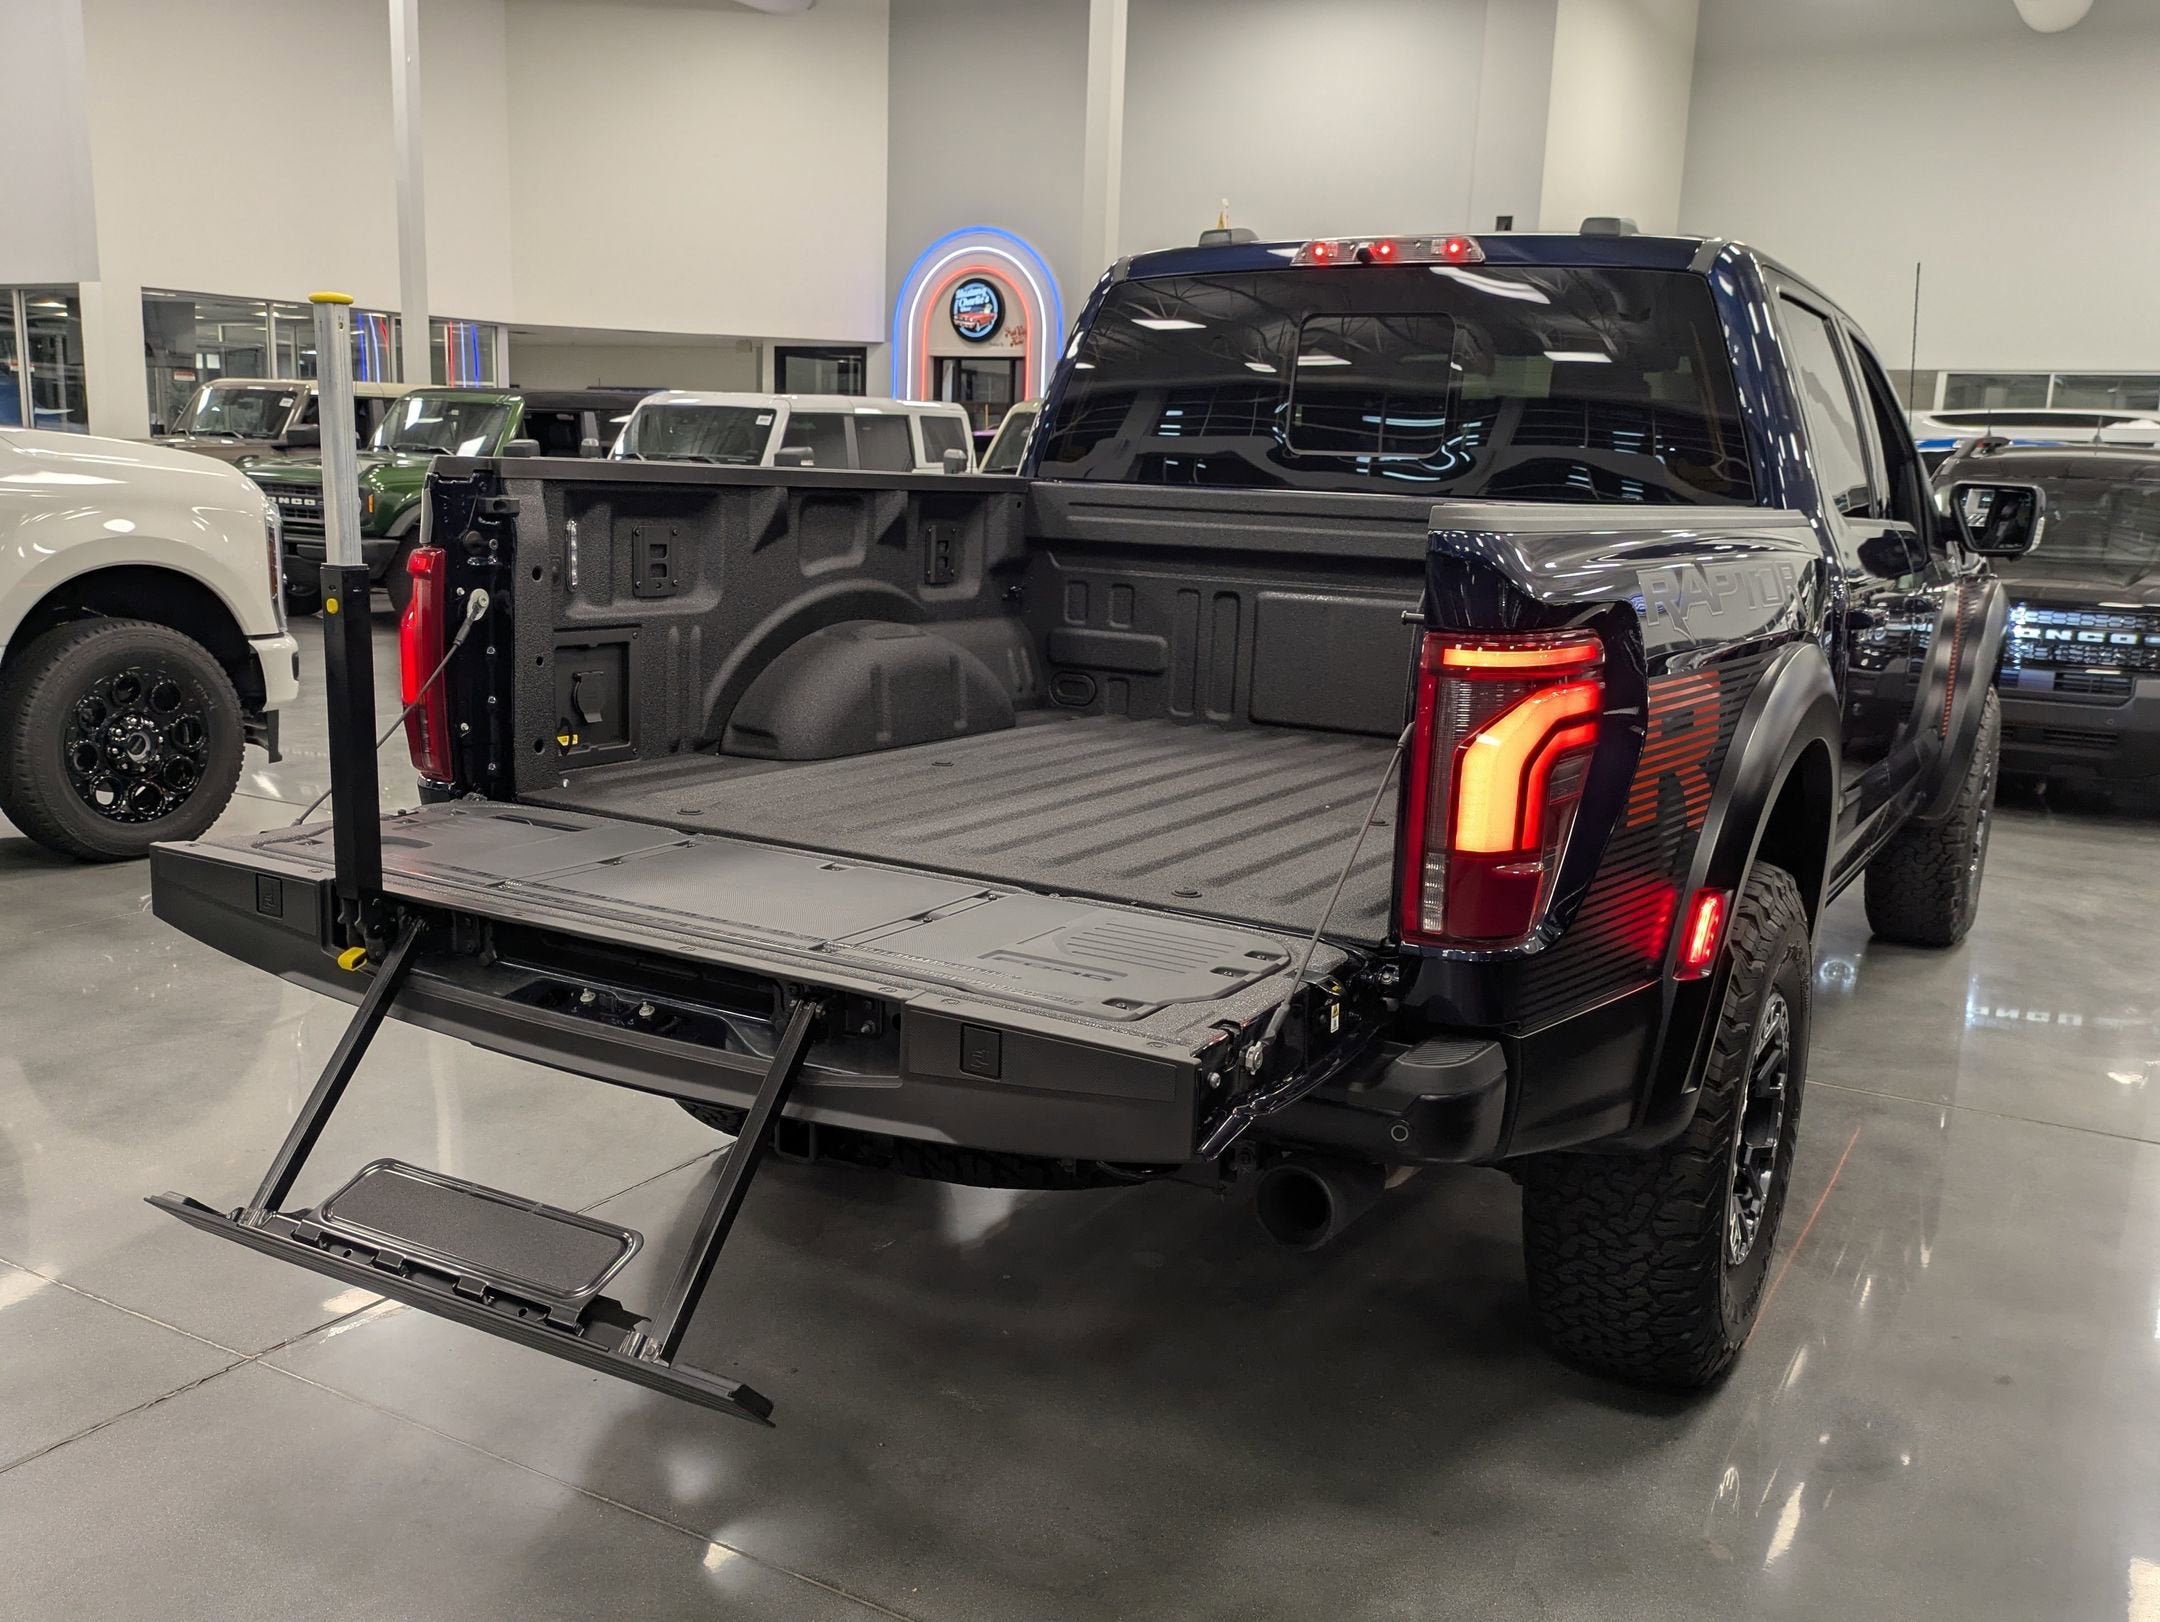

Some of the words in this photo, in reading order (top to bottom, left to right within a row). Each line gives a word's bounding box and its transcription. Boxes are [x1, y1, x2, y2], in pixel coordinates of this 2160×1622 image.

[267, 496, 316, 506] ONCO
[1636, 560, 1807, 646] RAPTOR
[2013, 627, 2138, 645] ONCO
